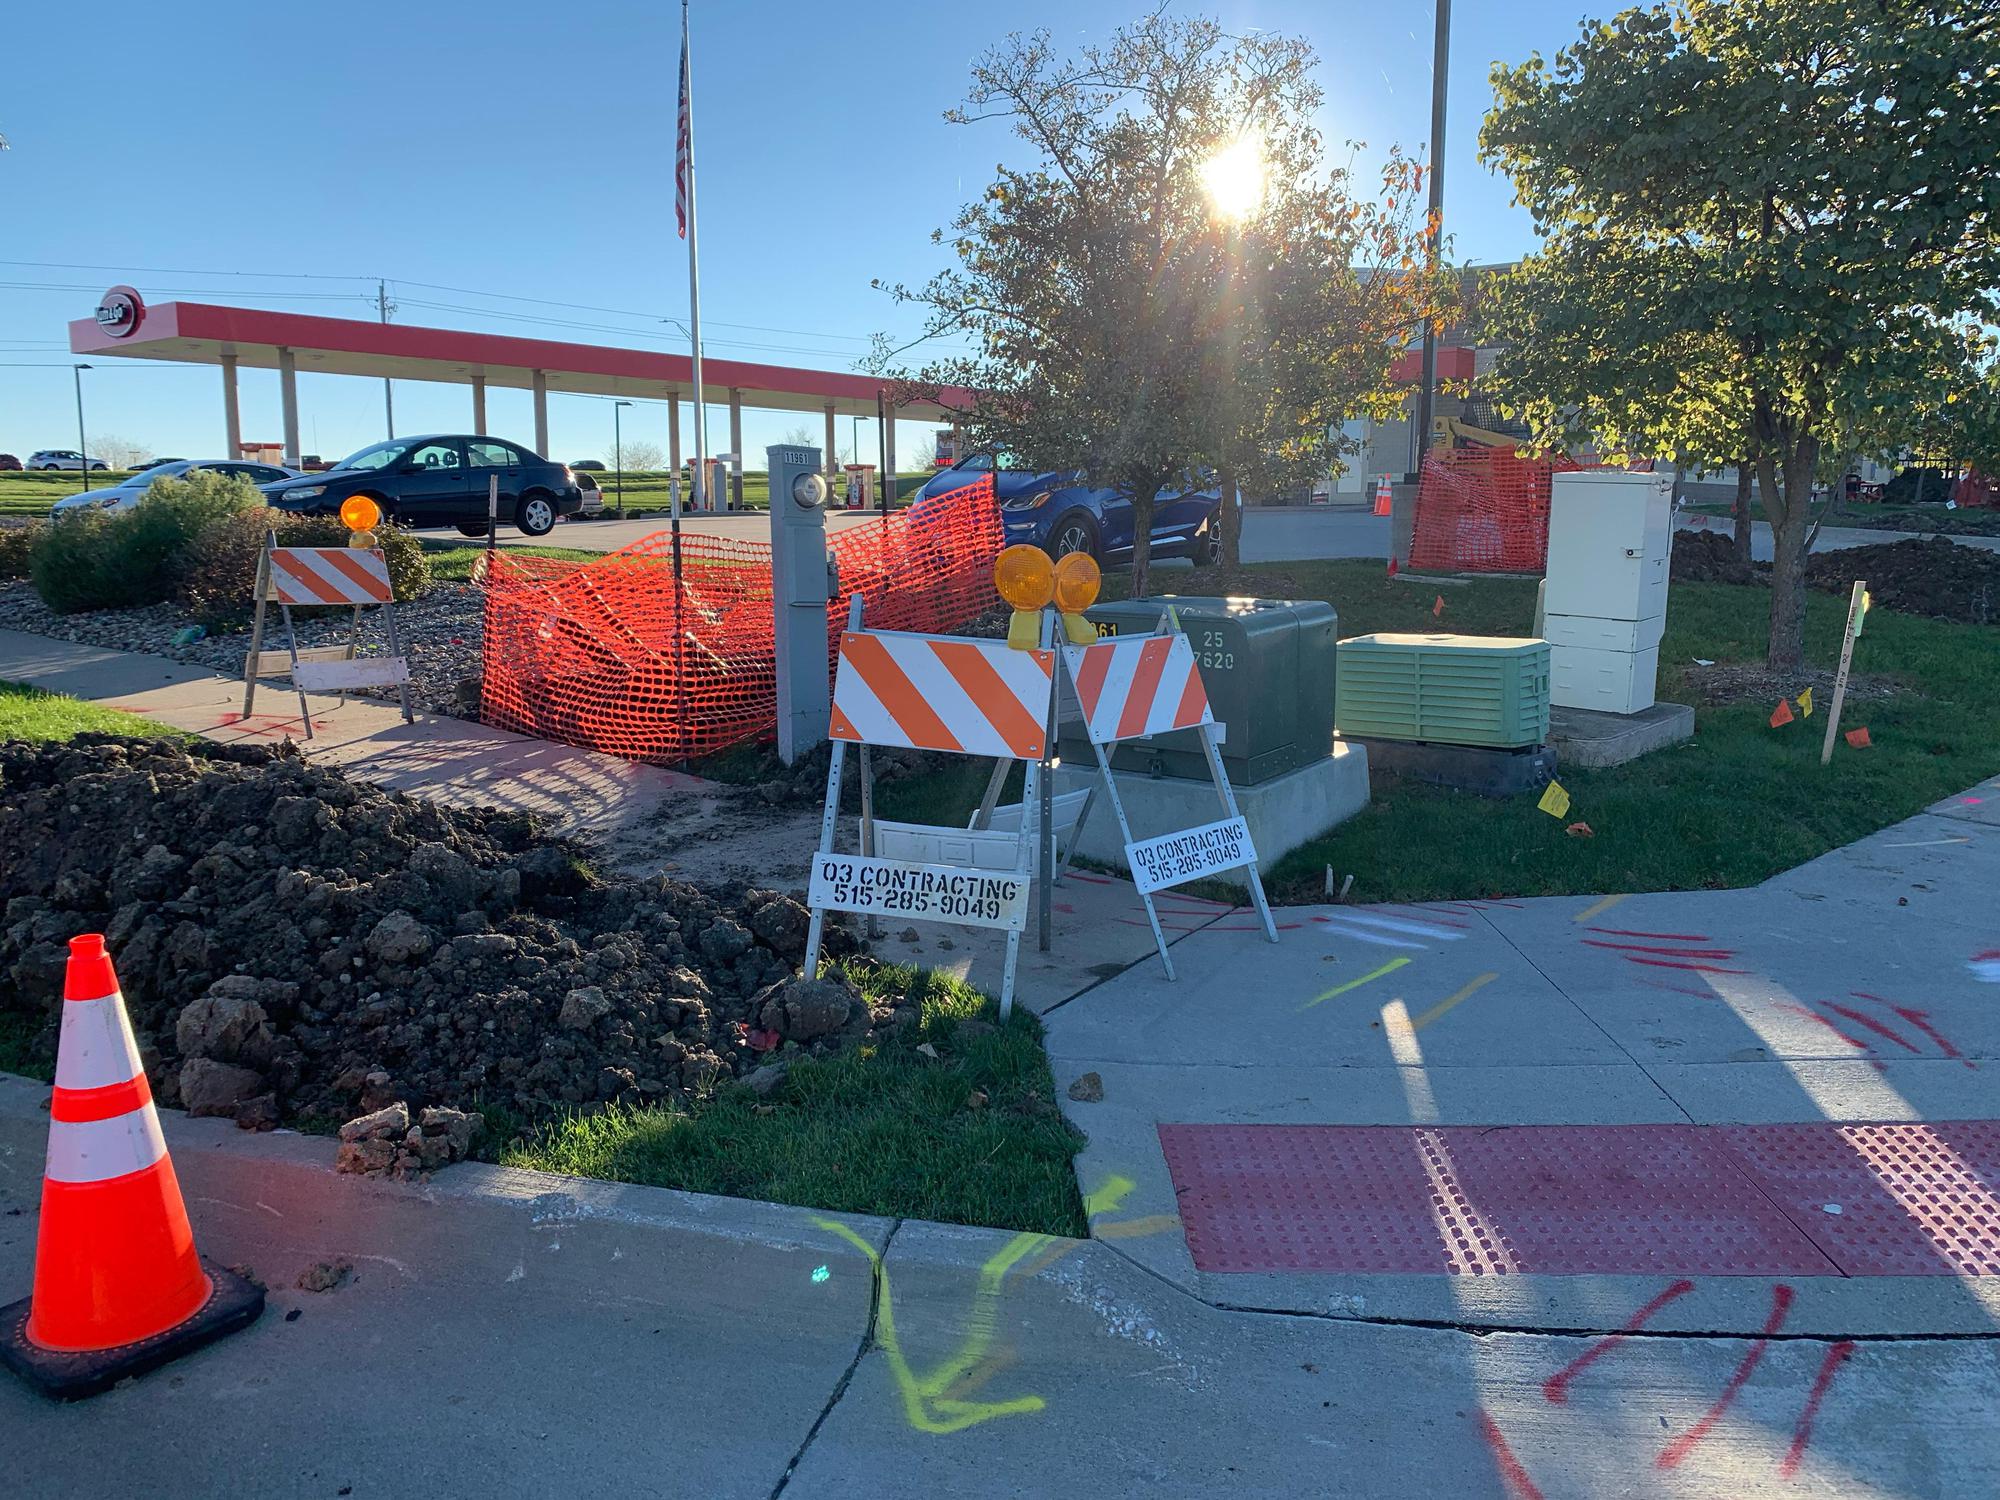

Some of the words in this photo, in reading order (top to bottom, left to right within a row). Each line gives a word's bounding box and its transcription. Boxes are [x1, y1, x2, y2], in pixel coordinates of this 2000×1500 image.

[785, 452, 808, 464] 11961
[1203, 631, 1223, 648] 25
[1156, 823, 1243, 861] CONTRACTING
[1148, 843, 1241, 883] 515-285-9049
[834, 883, 1000, 920] 515-285-9049
[860, 866, 1016, 901] CONTRACTING
